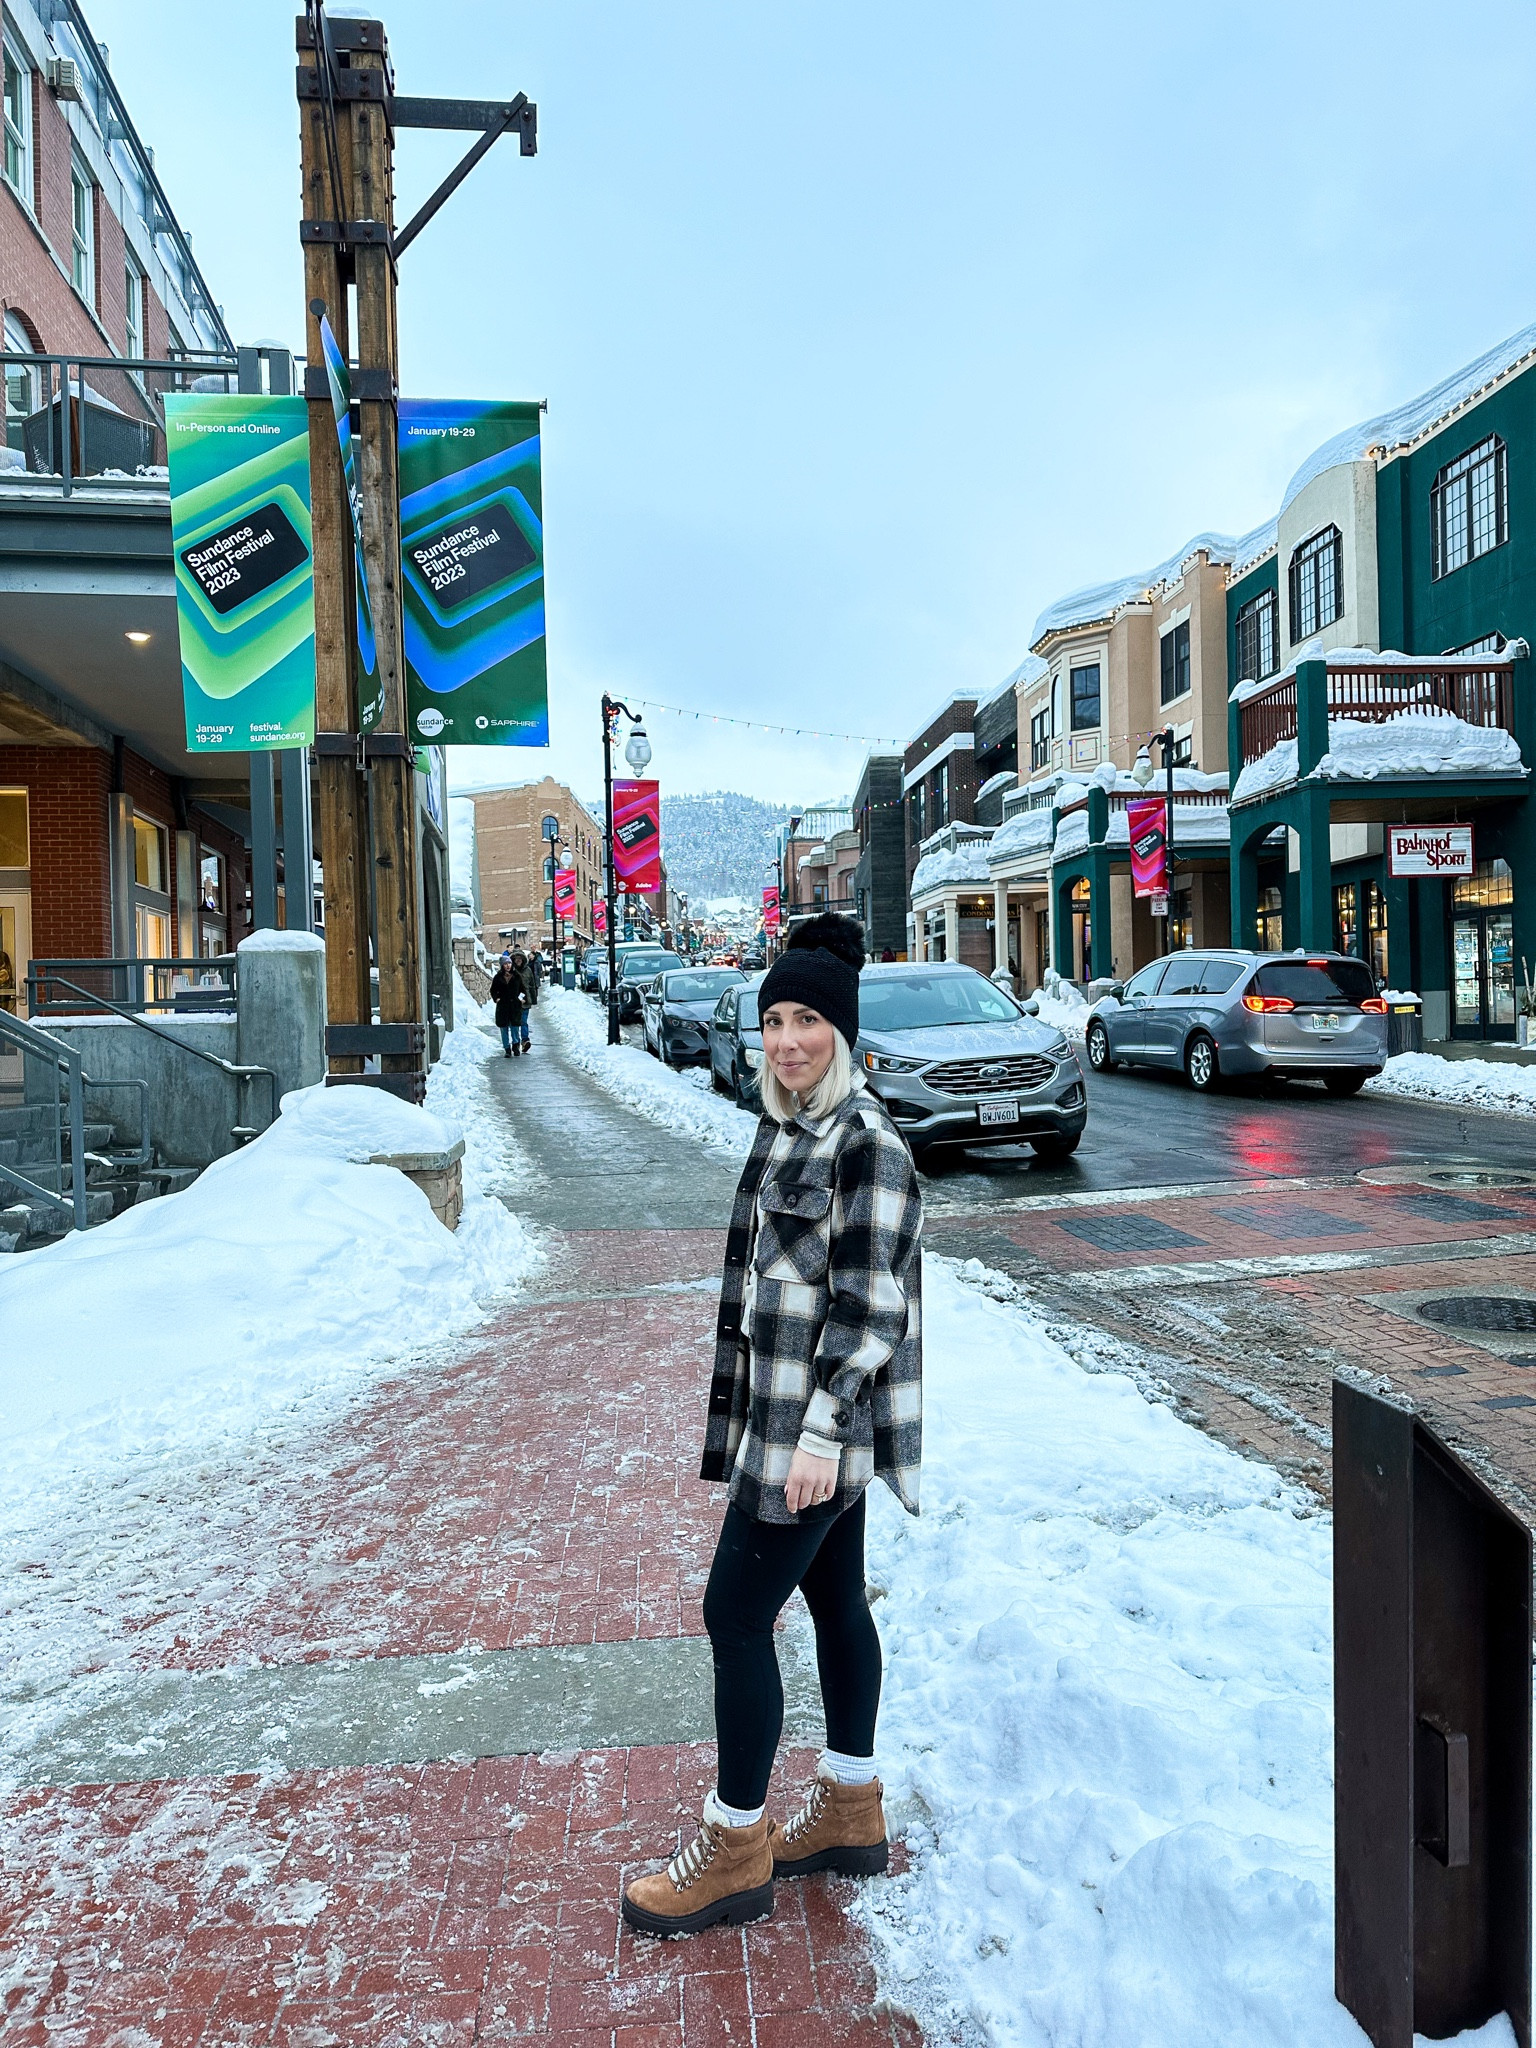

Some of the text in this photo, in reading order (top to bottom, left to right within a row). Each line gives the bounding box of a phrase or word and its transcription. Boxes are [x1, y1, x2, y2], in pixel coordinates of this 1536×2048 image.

[176, 422, 280, 434] In-Person and Online
[408, 426, 476, 437] January 19-29
[187, 526, 254, 568] Sundance
[195, 528, 275, 582] Film Festival
[413, 526, 480, 564] Sundance
[421, 528, 500, 578] Film Festival
[205, 567, 241, 596] 2023
[430, 563, 466, 591] 2023
[196, 724, 234, 734] January
[250, 722, 282, 732] festival.
[250, 732, 305, 742] sundance.org
[196, 734, 222, 742] 19-29
